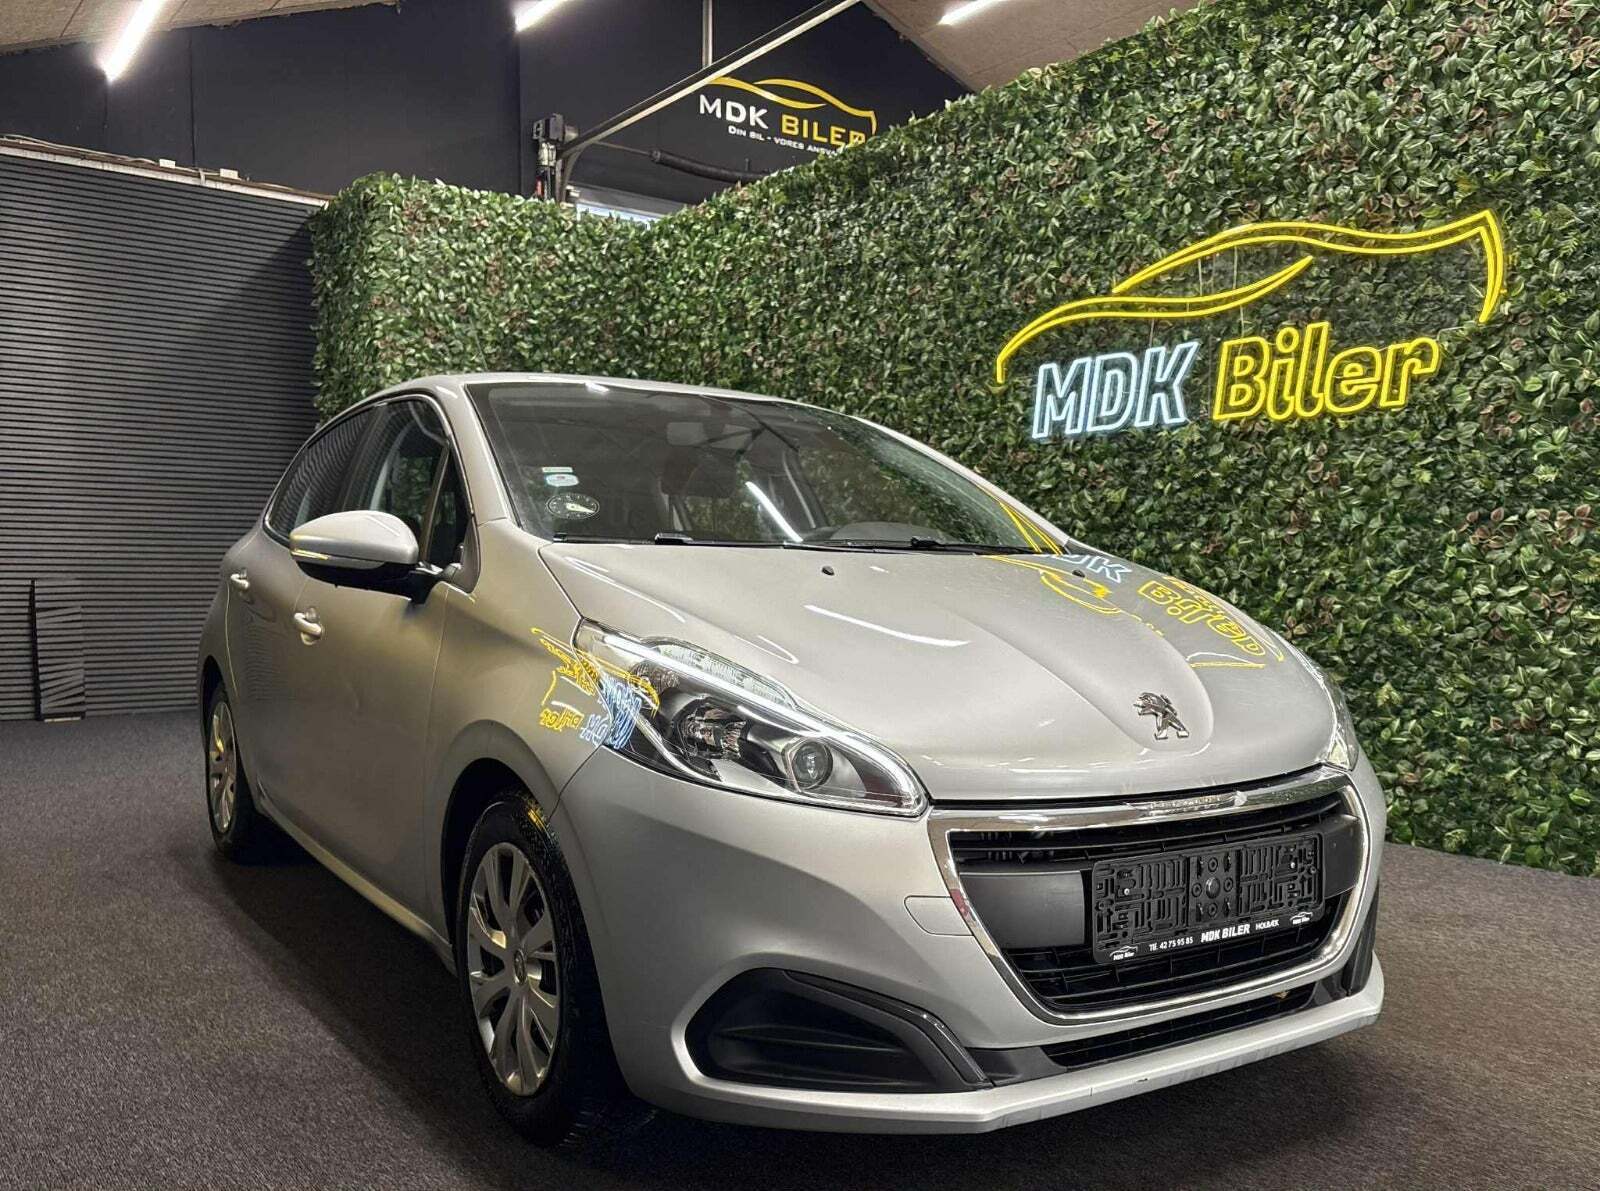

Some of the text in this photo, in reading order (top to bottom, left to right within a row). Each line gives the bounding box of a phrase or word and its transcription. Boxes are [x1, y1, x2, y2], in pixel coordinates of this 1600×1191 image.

[699, 94, 769, 129] MDK
[749, 131, 766, 141] BIL
[1032, 321, 1441, 439] MDK Biler
[1159, 940, 1168, 950] 42
[1168, 939, 1177, 948] 75
[1176, 937, 1185, 946] 95
[1185, 936, 1194, 945] 85
[1200, 923, 1251, 943] MDK BILER
